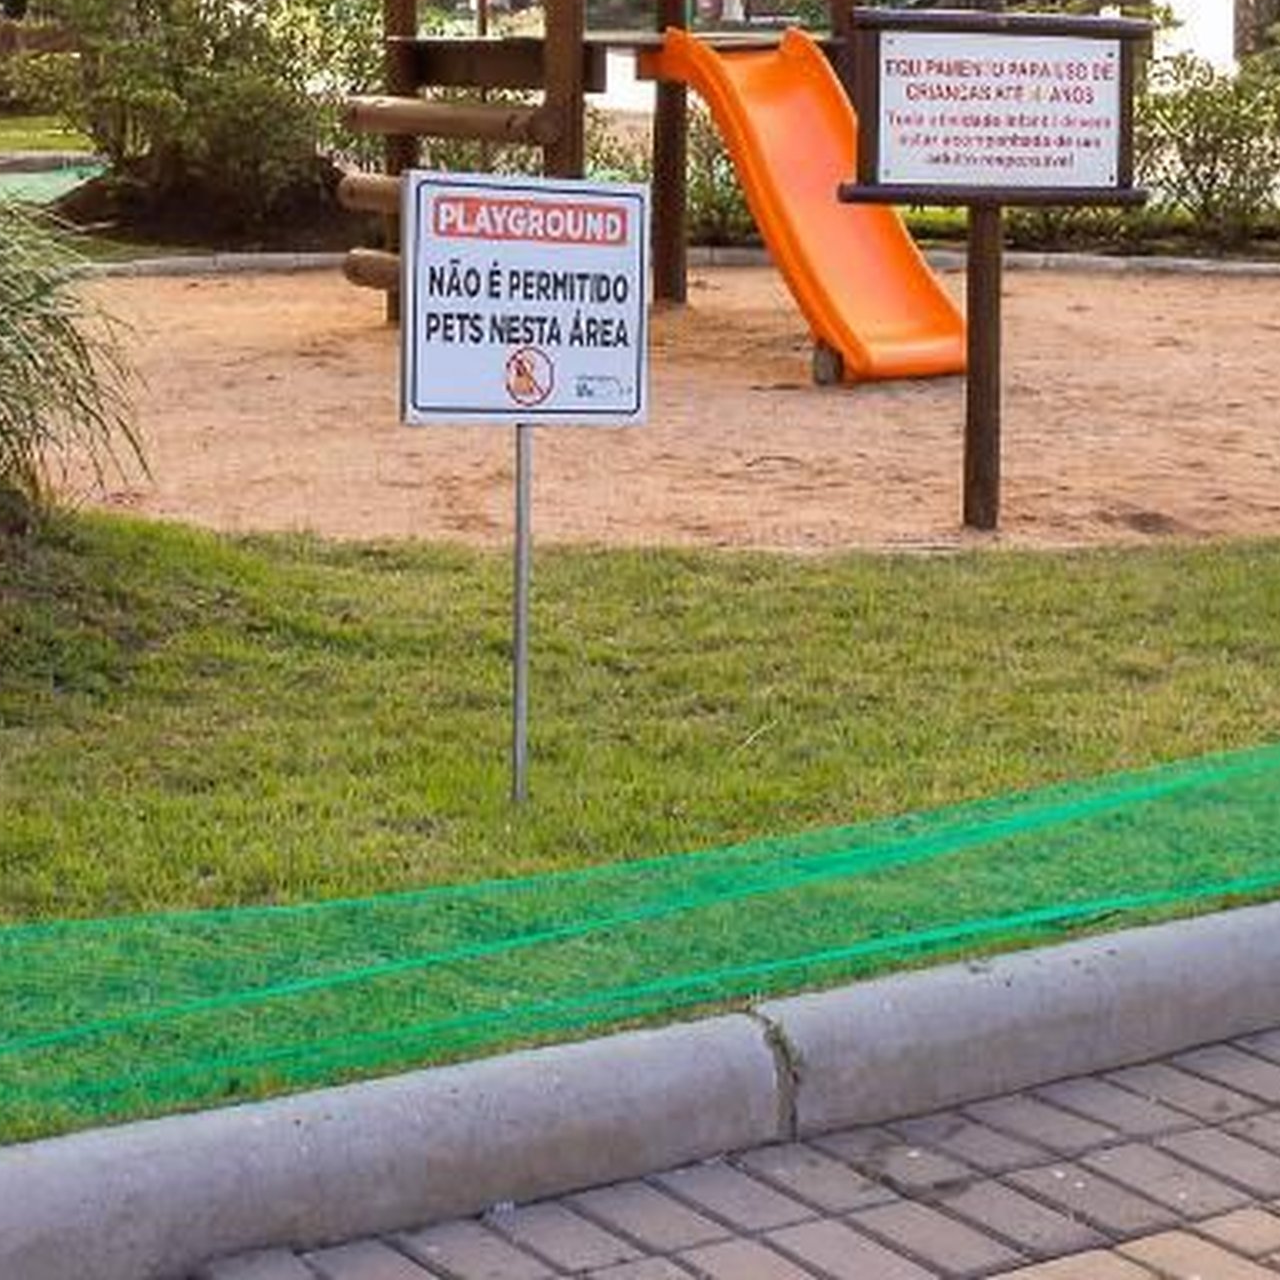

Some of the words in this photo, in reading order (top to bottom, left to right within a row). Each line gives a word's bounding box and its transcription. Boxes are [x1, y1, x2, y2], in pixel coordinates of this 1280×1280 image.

[885, 58, 1004, 78] EQUPAMENO
[438, 203, 622, 243] PLAYGROUND
[428, 259, 481, 299] NÃO
[488, 260, 502, 300] É
[508, 270, 629, 304] PERMITIDO
[425, 312, 485, 345] PETS
[489, 315, 563, 346] NESTA
[569, 309, 630, 348] ÁREA
